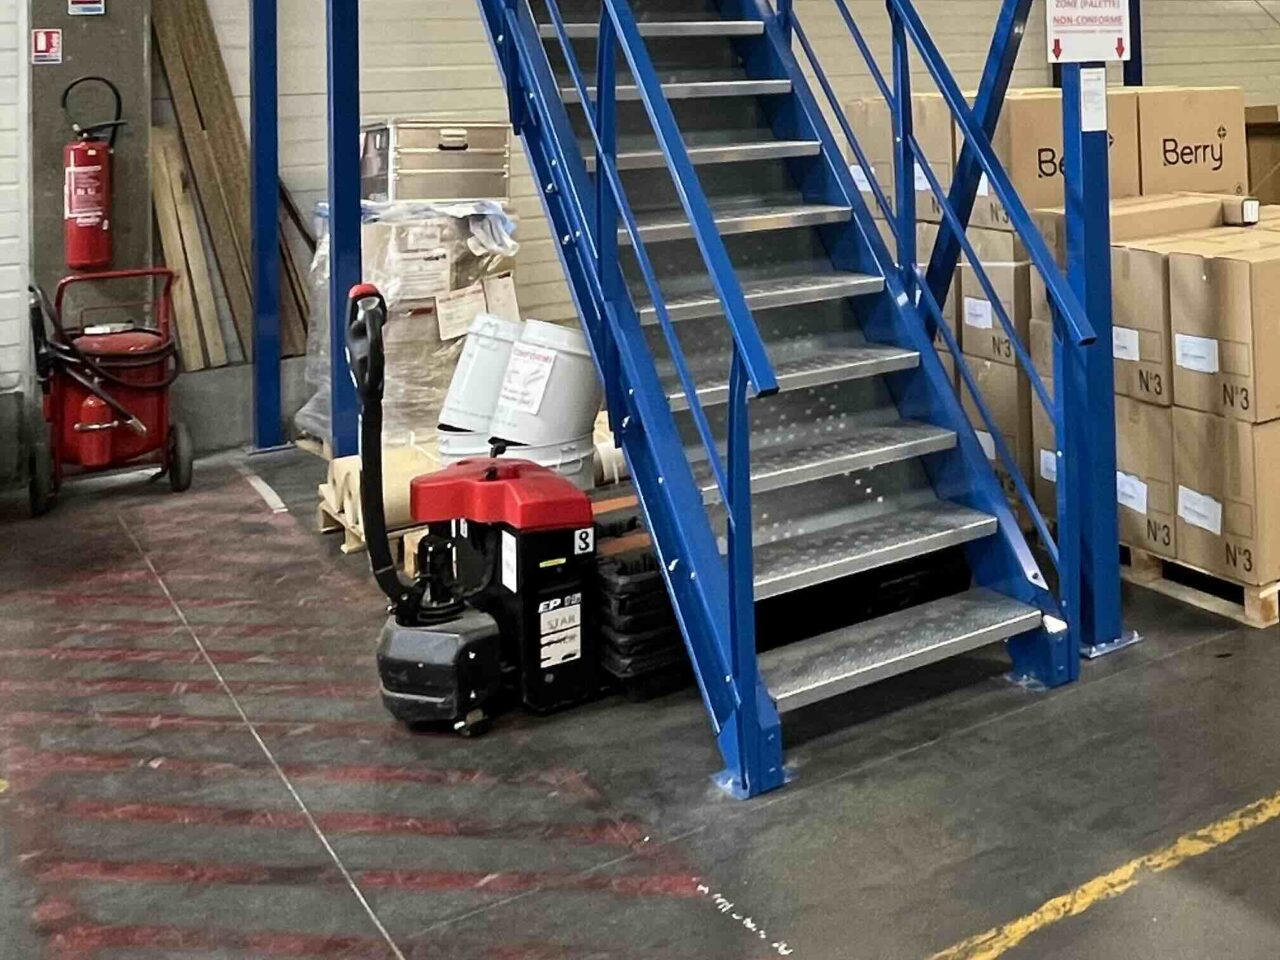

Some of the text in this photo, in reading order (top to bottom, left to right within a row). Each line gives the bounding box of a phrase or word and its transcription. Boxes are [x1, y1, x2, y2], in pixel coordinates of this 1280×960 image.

[1055, 0, 1077, 8] ZONE
[1163, 138, 1223, 171] Berry
[538, 598, 561, 613] EP
